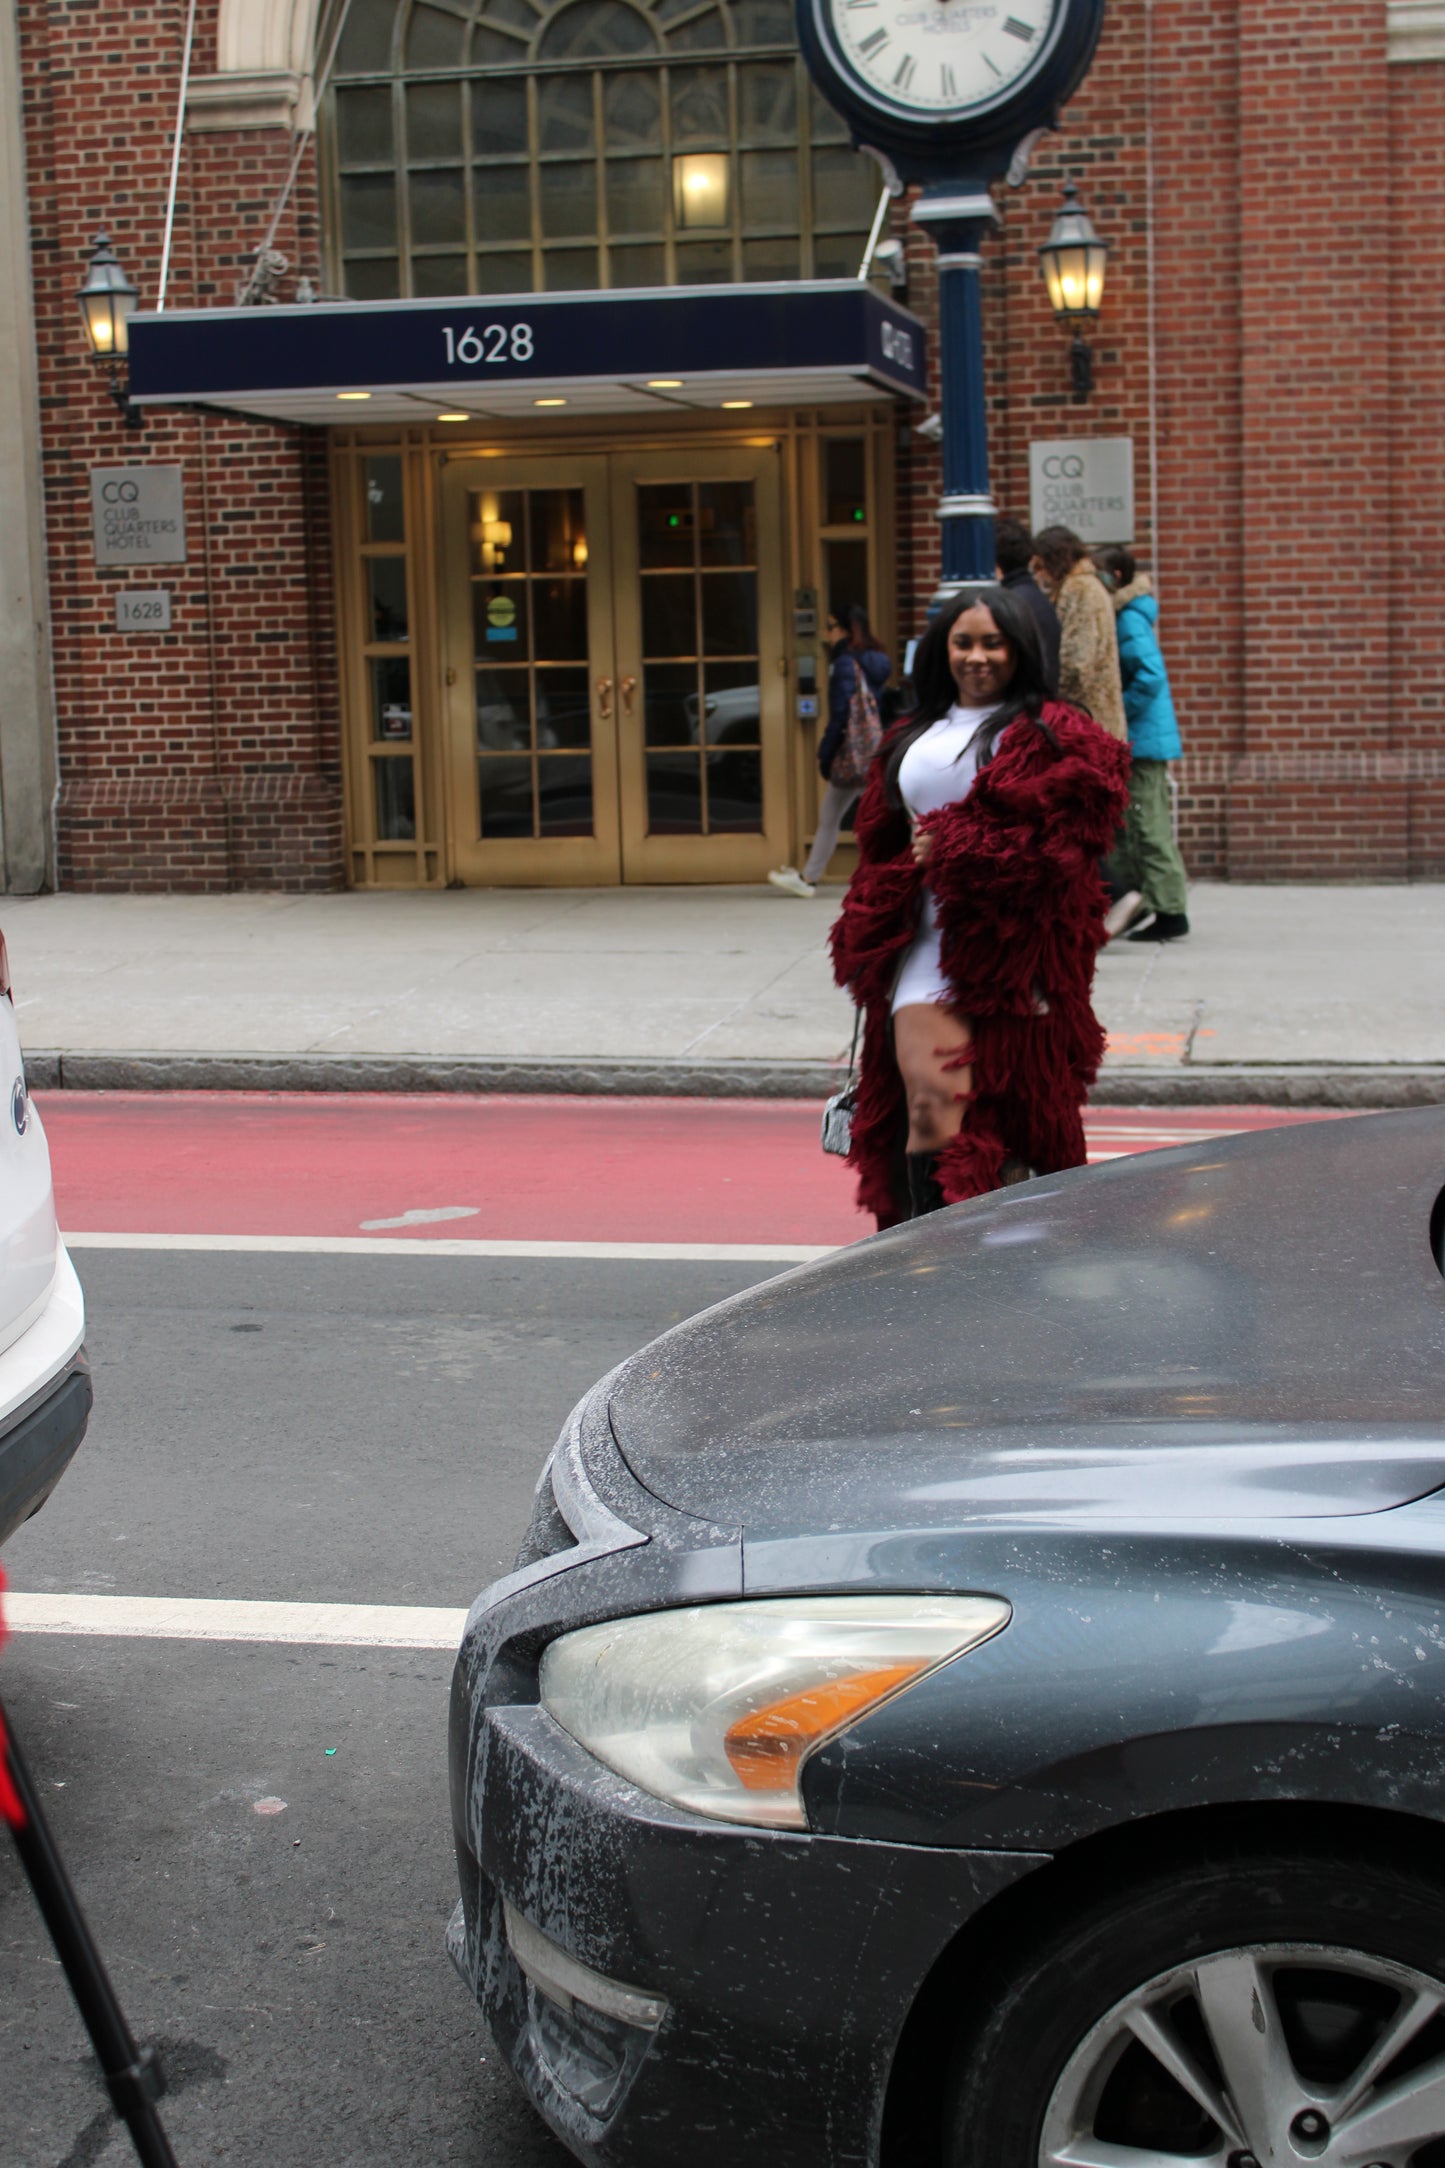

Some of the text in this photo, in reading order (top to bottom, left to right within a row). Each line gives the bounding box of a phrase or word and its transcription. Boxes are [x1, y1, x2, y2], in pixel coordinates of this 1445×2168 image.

[442, 323, 534, 364] 1628
[1042, 454, 1084, 479] CQ
[102, 480, 139, 504] CQ
[1043, 483, 1084, 498] CLUB
[1043, 496, 1125, 512] QUARTERS
[104, 507, 140, 521] CLUB
[104, 519, 177, 536] QUARTERS
[105, 536, 151, 549] HOTEL
[122, 602, 163, 620] 1628
